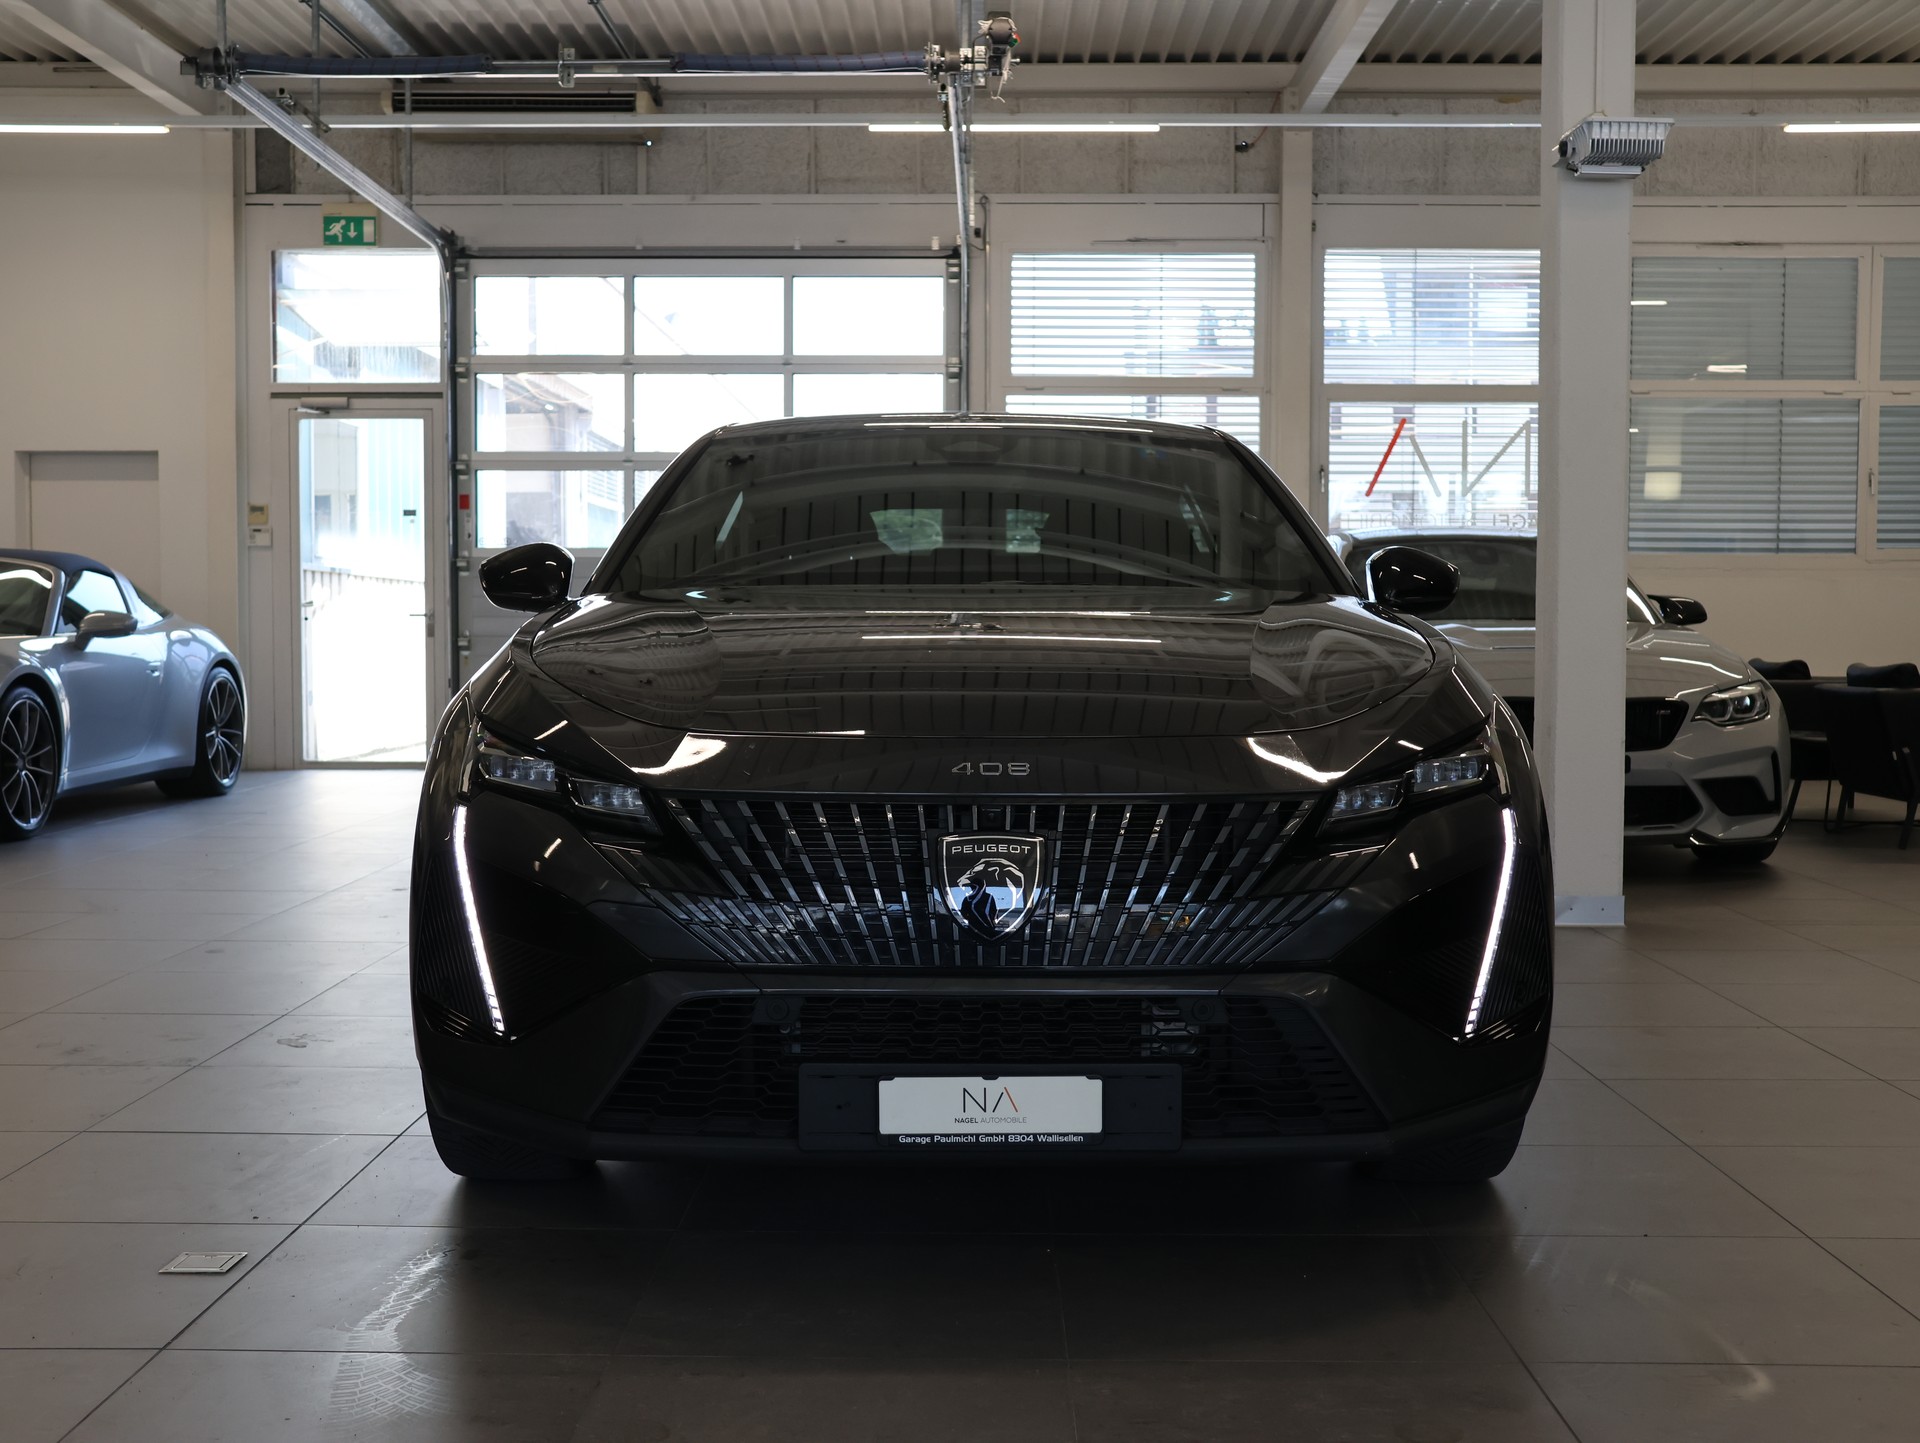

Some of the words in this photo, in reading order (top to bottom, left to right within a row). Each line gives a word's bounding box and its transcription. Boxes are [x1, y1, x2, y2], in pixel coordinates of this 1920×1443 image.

[951, 761, 1031, 776] 408
[951, 844, 1031, 855] PEUGEOT
[898, 1135, 931, 1145] Garage
[934, 1134, 976, 1143] Paulmichl
[978, 1134, 1005, 1143] GmbH
[1007, 1134, 1034, 1143] 8304
[1036, 1133, 1084, 1143] Wallisellen
